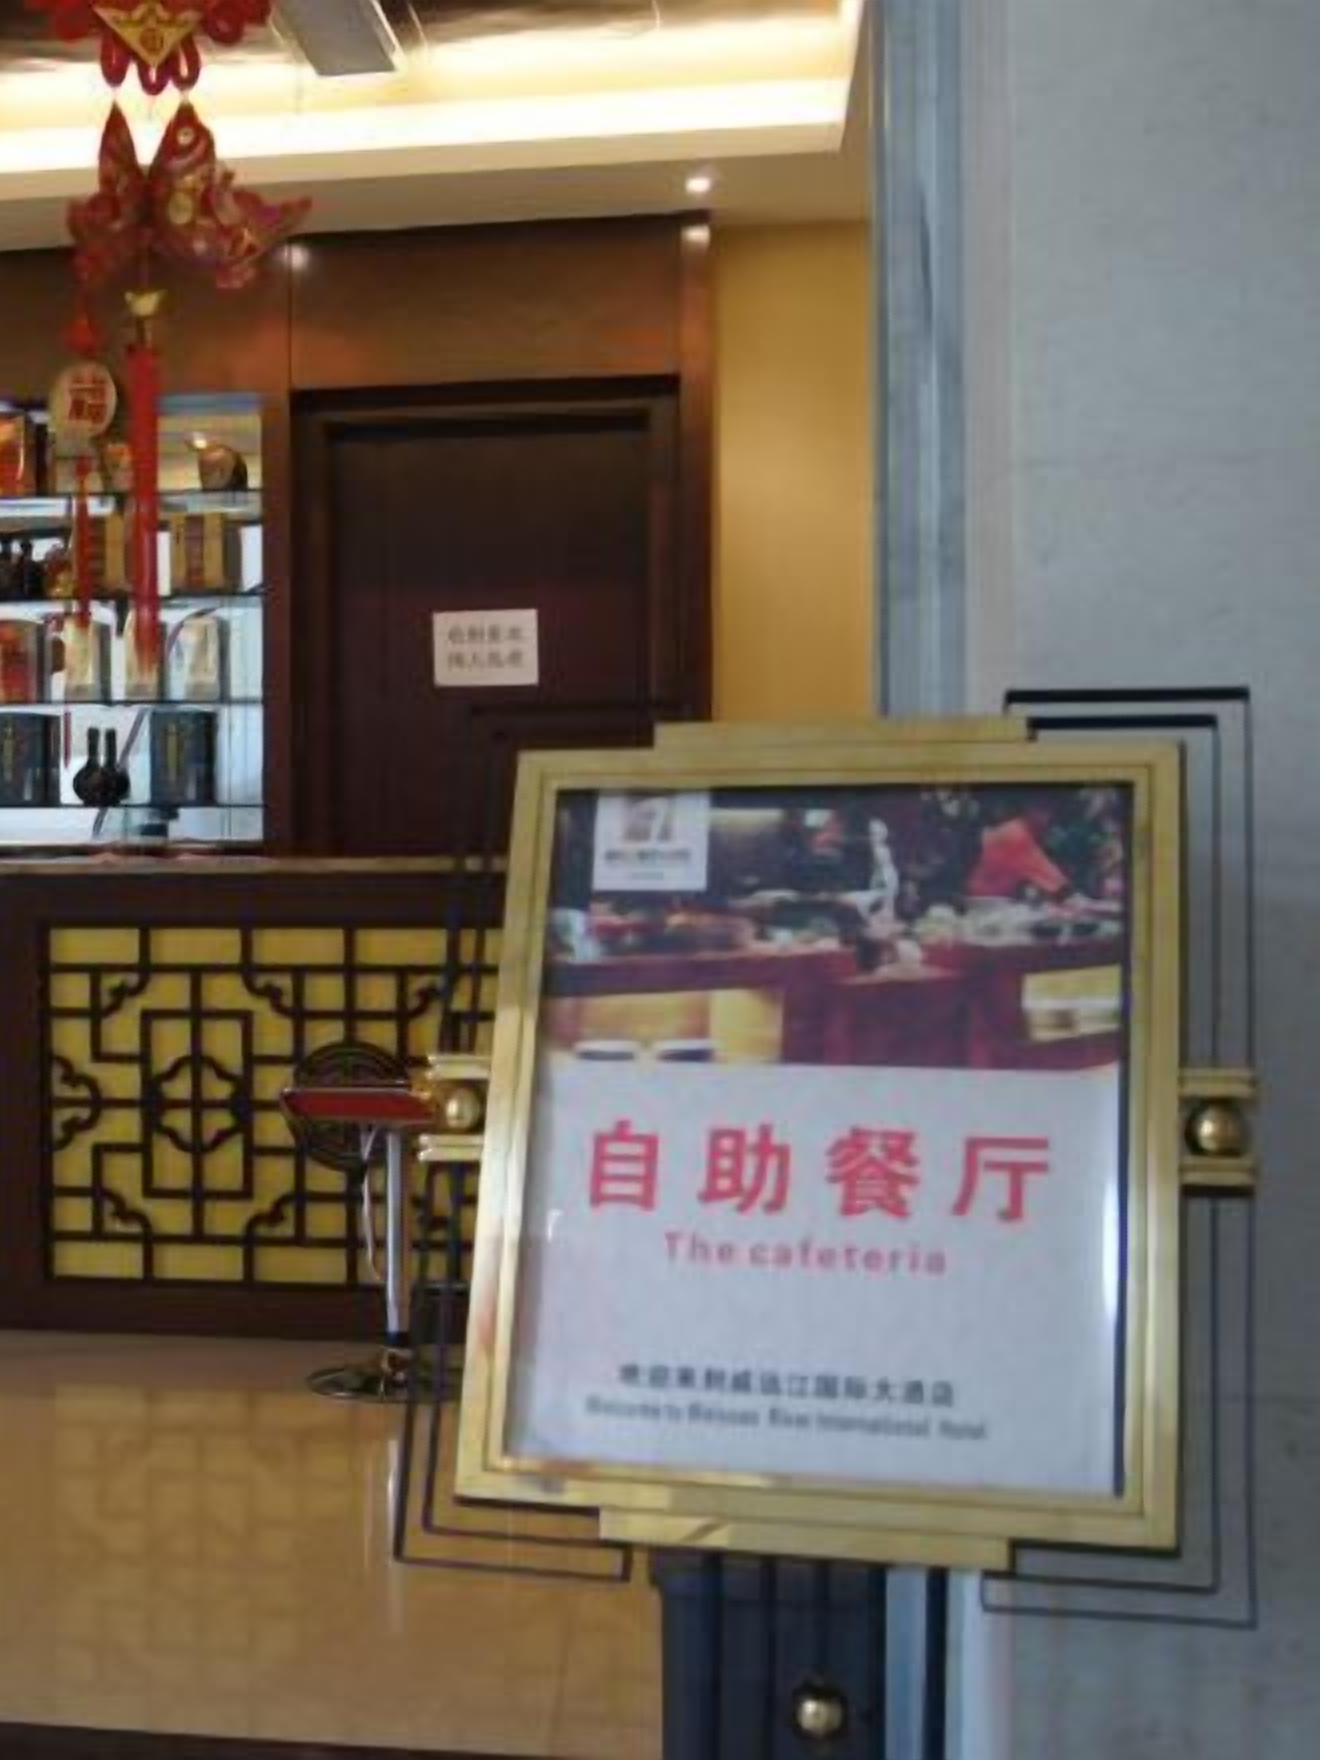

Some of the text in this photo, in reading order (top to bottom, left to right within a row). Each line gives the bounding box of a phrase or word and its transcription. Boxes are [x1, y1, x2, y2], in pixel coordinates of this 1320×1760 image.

[587, 1118, 1051, 1223] 自助餐厅
[664, 1230, 948, 1276] The cafeteria
